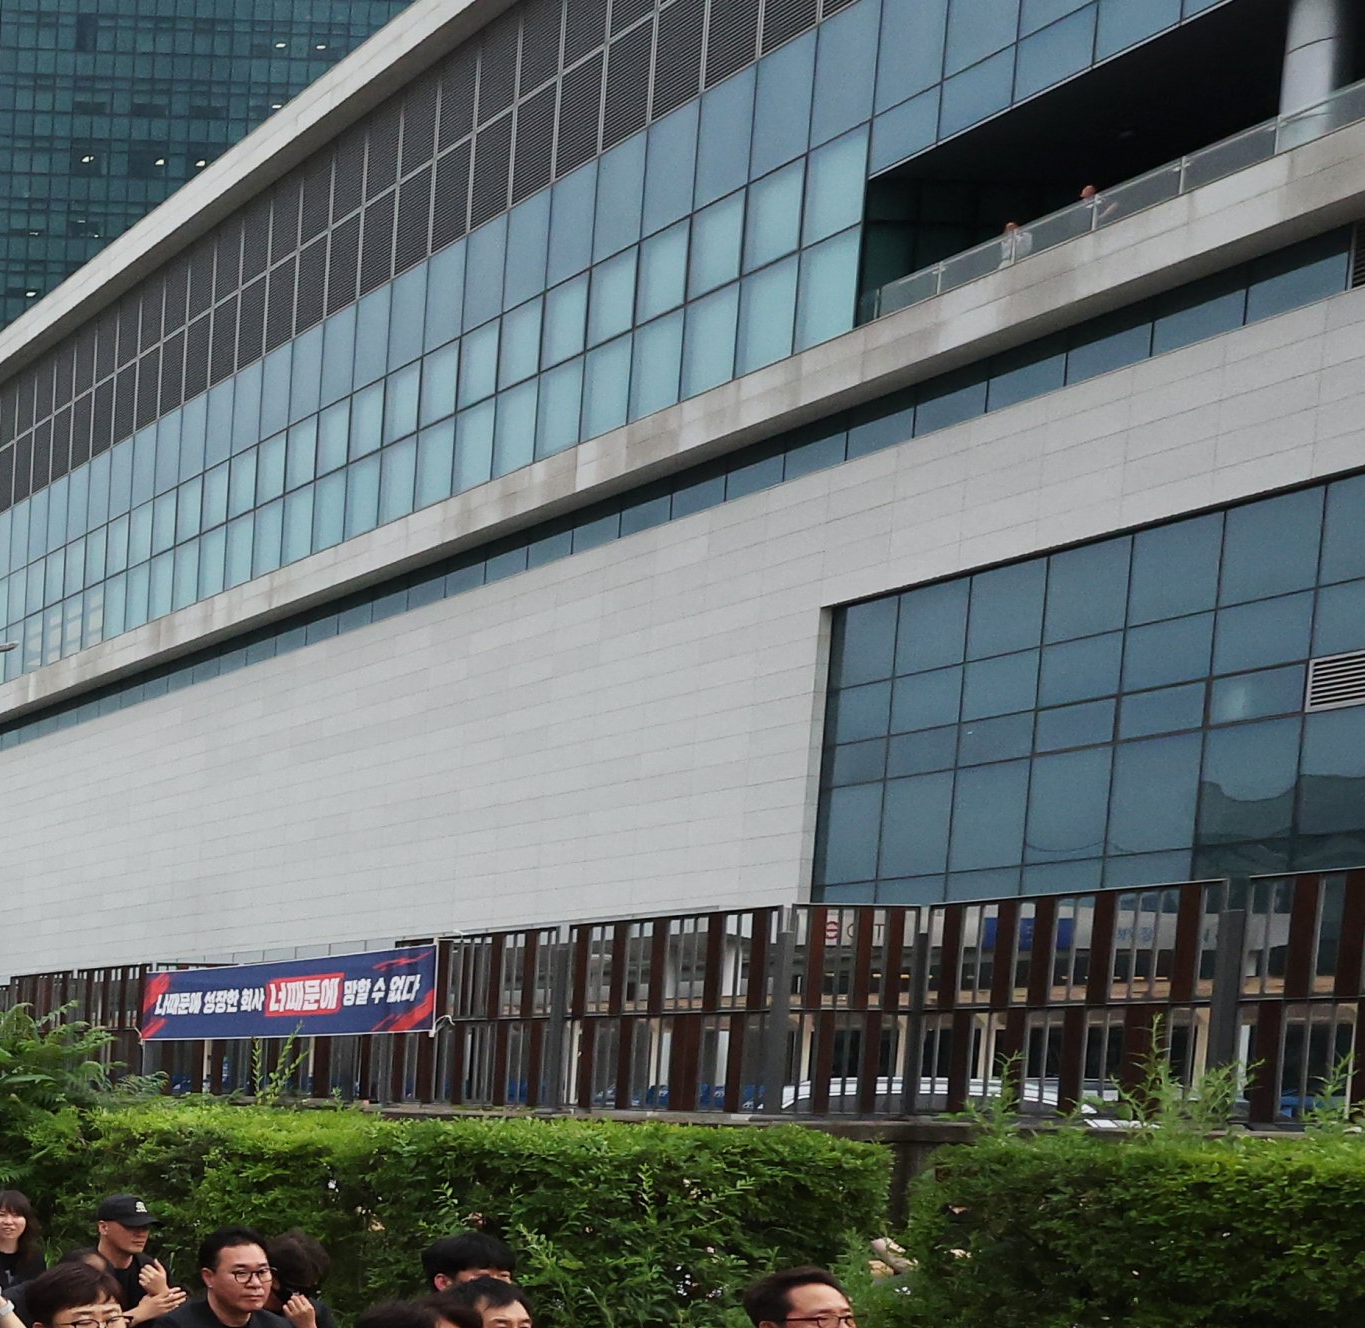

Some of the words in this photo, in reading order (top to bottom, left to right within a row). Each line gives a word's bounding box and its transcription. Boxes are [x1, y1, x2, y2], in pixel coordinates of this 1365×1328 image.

[203, 989, 239, 1014] 성장한
[240, 987, 265, 1012] 회사
[269, 977, 341, 1012] 너때문에
[343, 979, 372, 1007] 망할
[372, 983, 387, 1005] 수
[386, 974, 421, 1003] 없다
